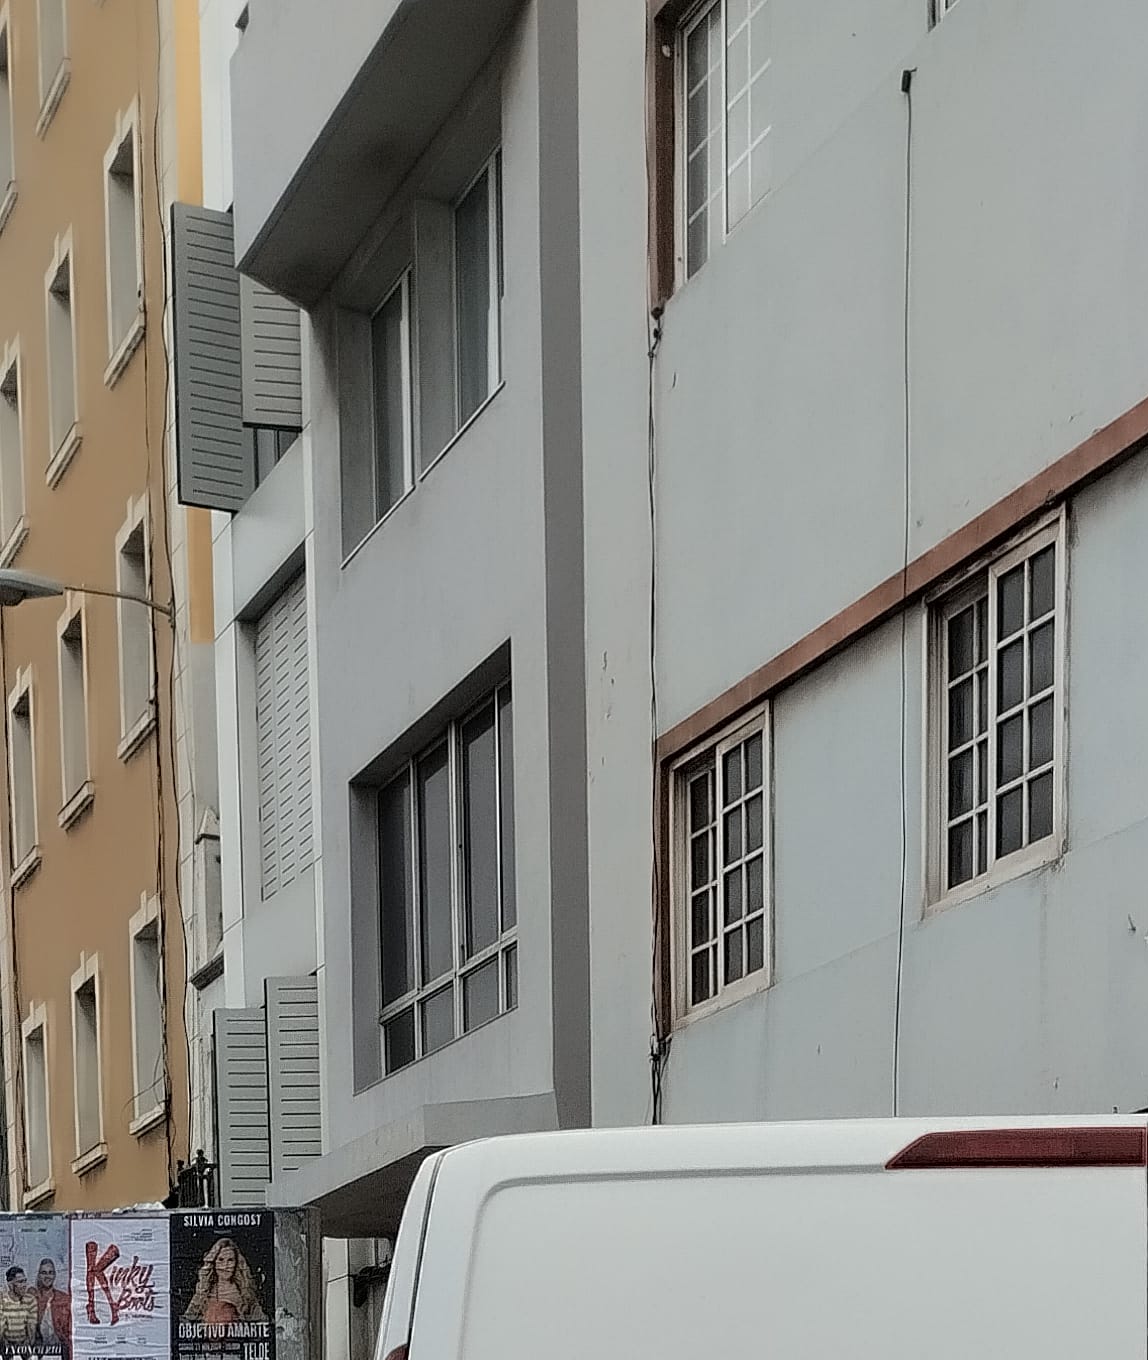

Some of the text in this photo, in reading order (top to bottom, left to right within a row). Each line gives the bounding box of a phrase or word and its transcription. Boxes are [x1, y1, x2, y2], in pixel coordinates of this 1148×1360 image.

[183, 1213, 261, 1227] SILVIA CONGOST
[178, 1322, 270, 1338] OBJETIVO AMARTE
[243, 1342, 270, 1360] TELDE
